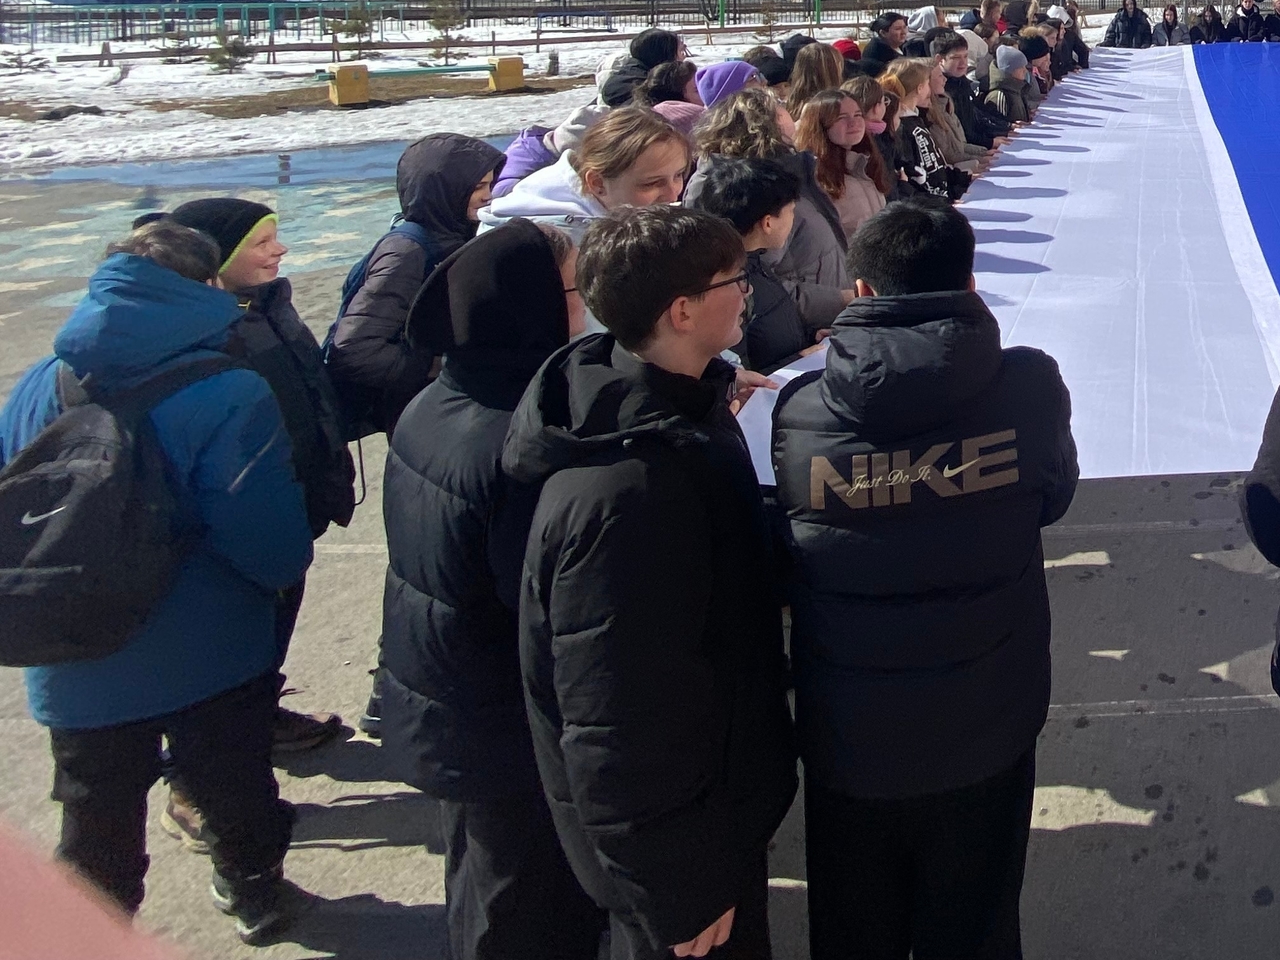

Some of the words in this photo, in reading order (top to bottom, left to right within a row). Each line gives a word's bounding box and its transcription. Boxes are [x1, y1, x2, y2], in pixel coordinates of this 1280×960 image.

[918, 135, 933, 168] MOTION
[810, 428, 1020, 511] NIKE
[846, 473, 883, 497] Just
[885, 468, 910, 486] Do
